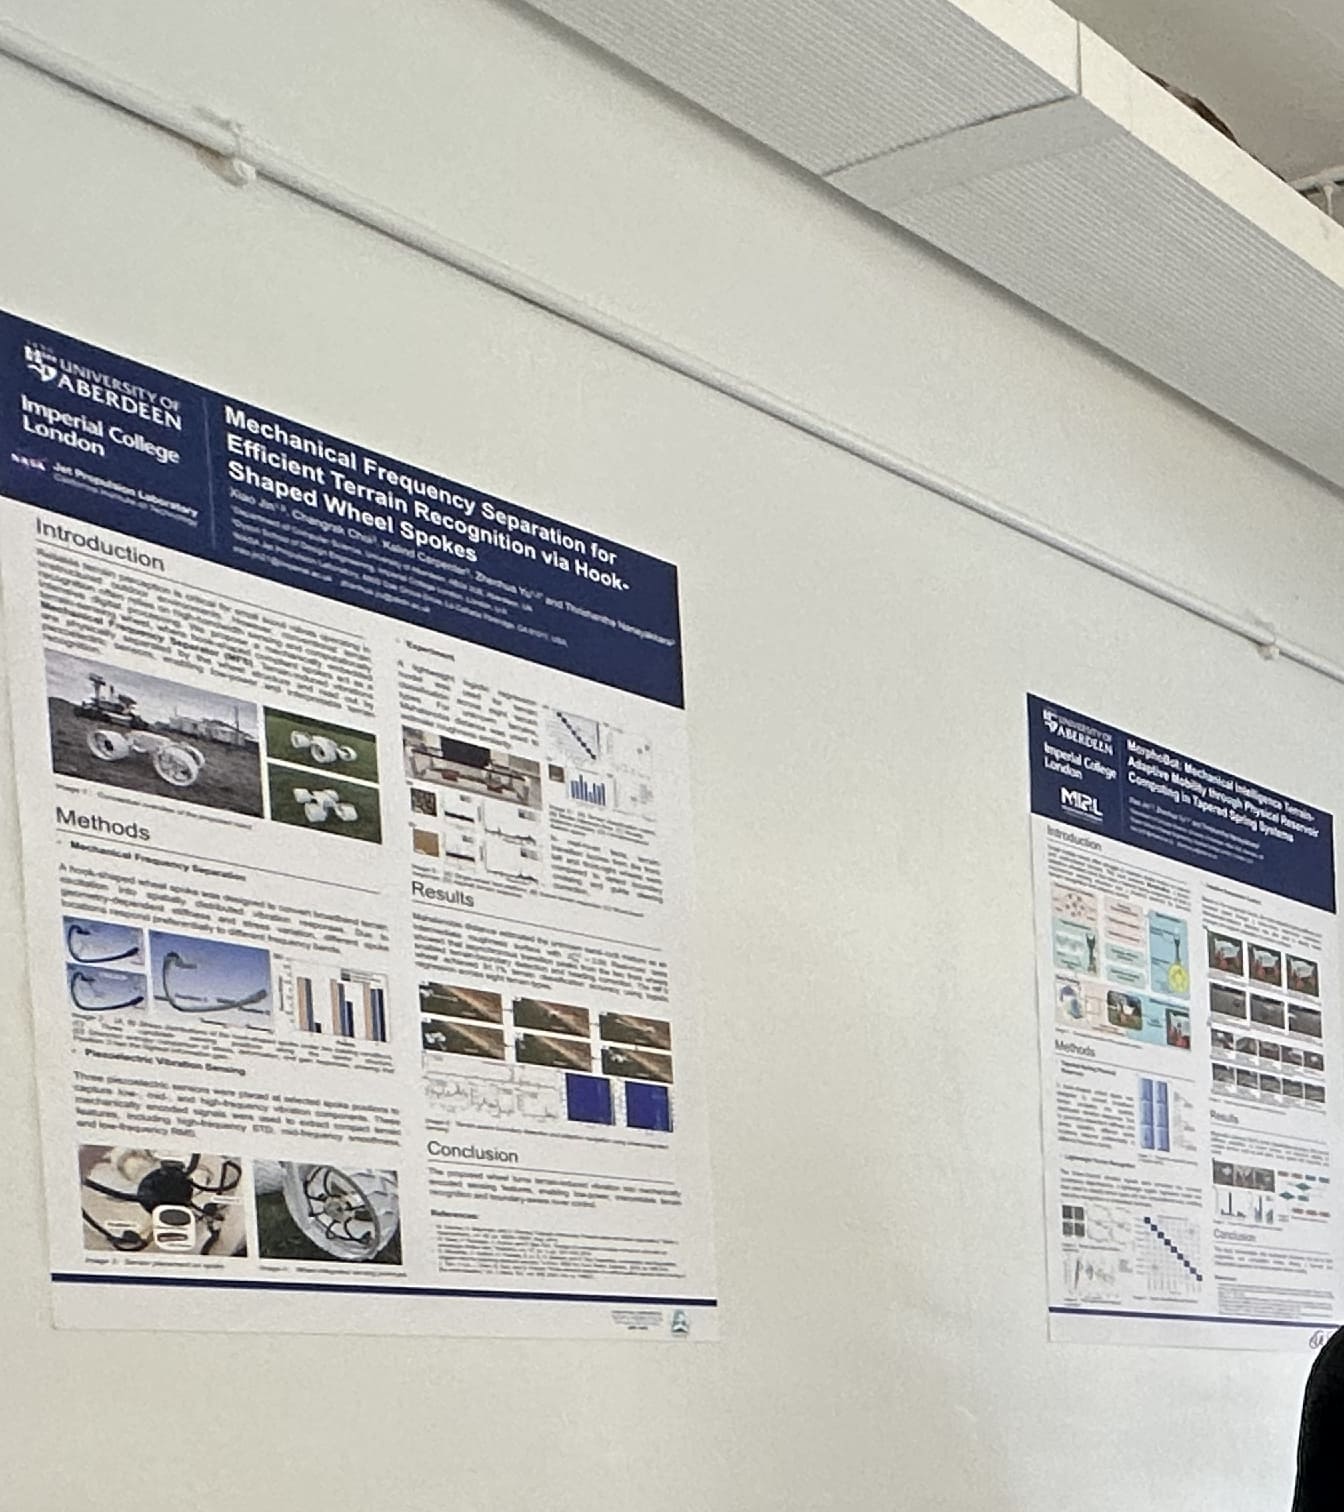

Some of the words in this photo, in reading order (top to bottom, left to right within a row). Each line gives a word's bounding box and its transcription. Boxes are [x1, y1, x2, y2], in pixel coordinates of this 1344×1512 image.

[56, 370, 182, 432] ABERDEEN
[59, 357, 157, 405] UNIVERSITY
[159, 394, 180, 414] OF
[20, 393, 104, 442] Imperial
[108, 423, 181, 470] College
[22, 413, 105, 458] London
[52, 461, 73, 479] Jet
[137, 489, 199, 520] Laboratory
[224, 404, 356, 471] Mechanical
[362, 456, 475, 518] Frequency
[480, 500, 585, 558] Separation
[590, 540, 617, 567] for
[226, 431, 324, 485] Efficient
[330, 469, 407, 515] Terrain
[413, 499, 536, 564] Recognition
[541, 546, 569, 572] via
[574, 558, 629, 594] Hook-
[227, 458, 317, 511] Shaped
[323, 492, 393, 535] Wheel
[399, 519, 477, 567] Spokes
[36, 517, 164, 572] Introduction
[1044, 755, 1082, 780] London
[56, 806, 150, 842] Methods
[411, 879, 474, 907] Results
[427, 1140, 518, 1163] Conclusion
